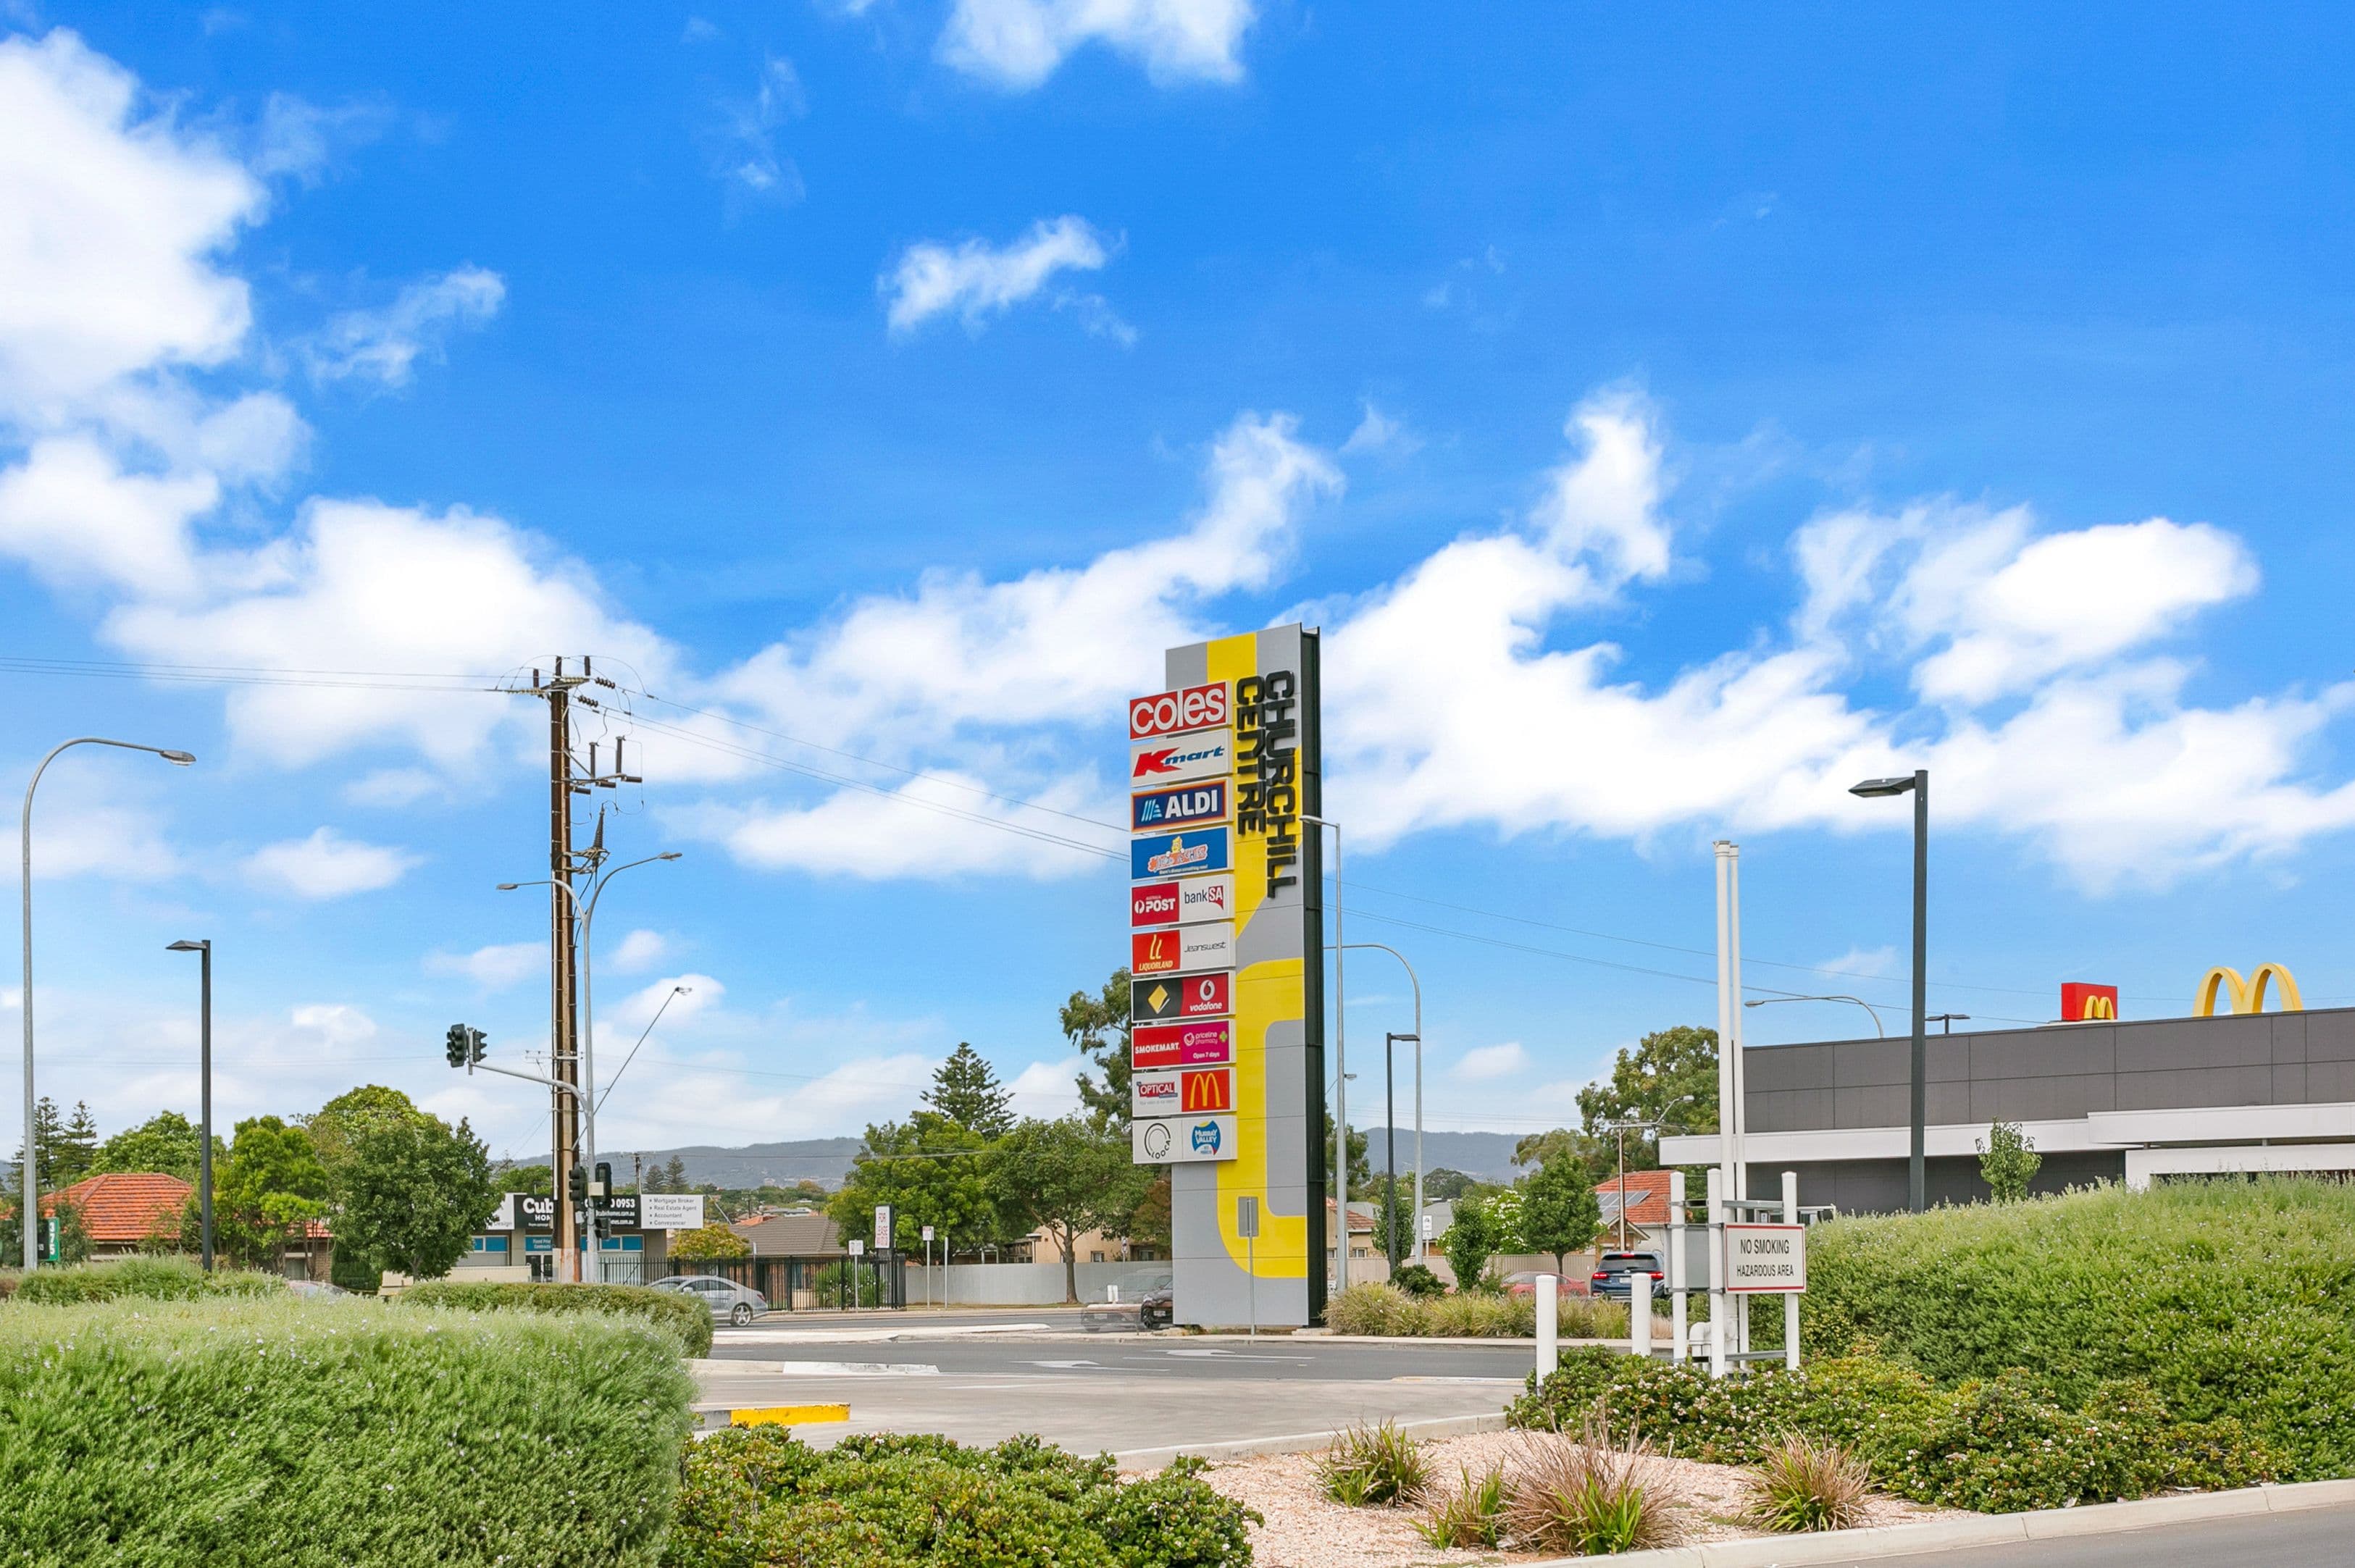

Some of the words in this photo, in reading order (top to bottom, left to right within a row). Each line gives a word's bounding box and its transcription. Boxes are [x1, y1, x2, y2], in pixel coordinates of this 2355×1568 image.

[1132, 689, 1225, 734] coles
[1133, 746, 1224, 778] Kmart
[1237, 676, 1266, 835] CENTRE
[1266, 670, 1297, 898] CHURCHILL
[1165, 789, 1218, 819] ALDI
[1145, 898, 1176, 913] POST
[1138, 960, 1174, 971] LIQUORLAND
[1189, 1002, 1223, 1012] vodafone
[1135, 1042, 1180, 1054] SMOKEMART
[1140, 1083, 1174, 1094] OPTICAL
[616, 1199, 635, 1208] 0953
[1740, 1239, 1752, 1254] NO
[1754, 1239, 1790, 1254] SMOKING
[1736, 1265, 1775, 1277] HAZARDOUS
[1777, 1265, 1794, 1276] AREA
